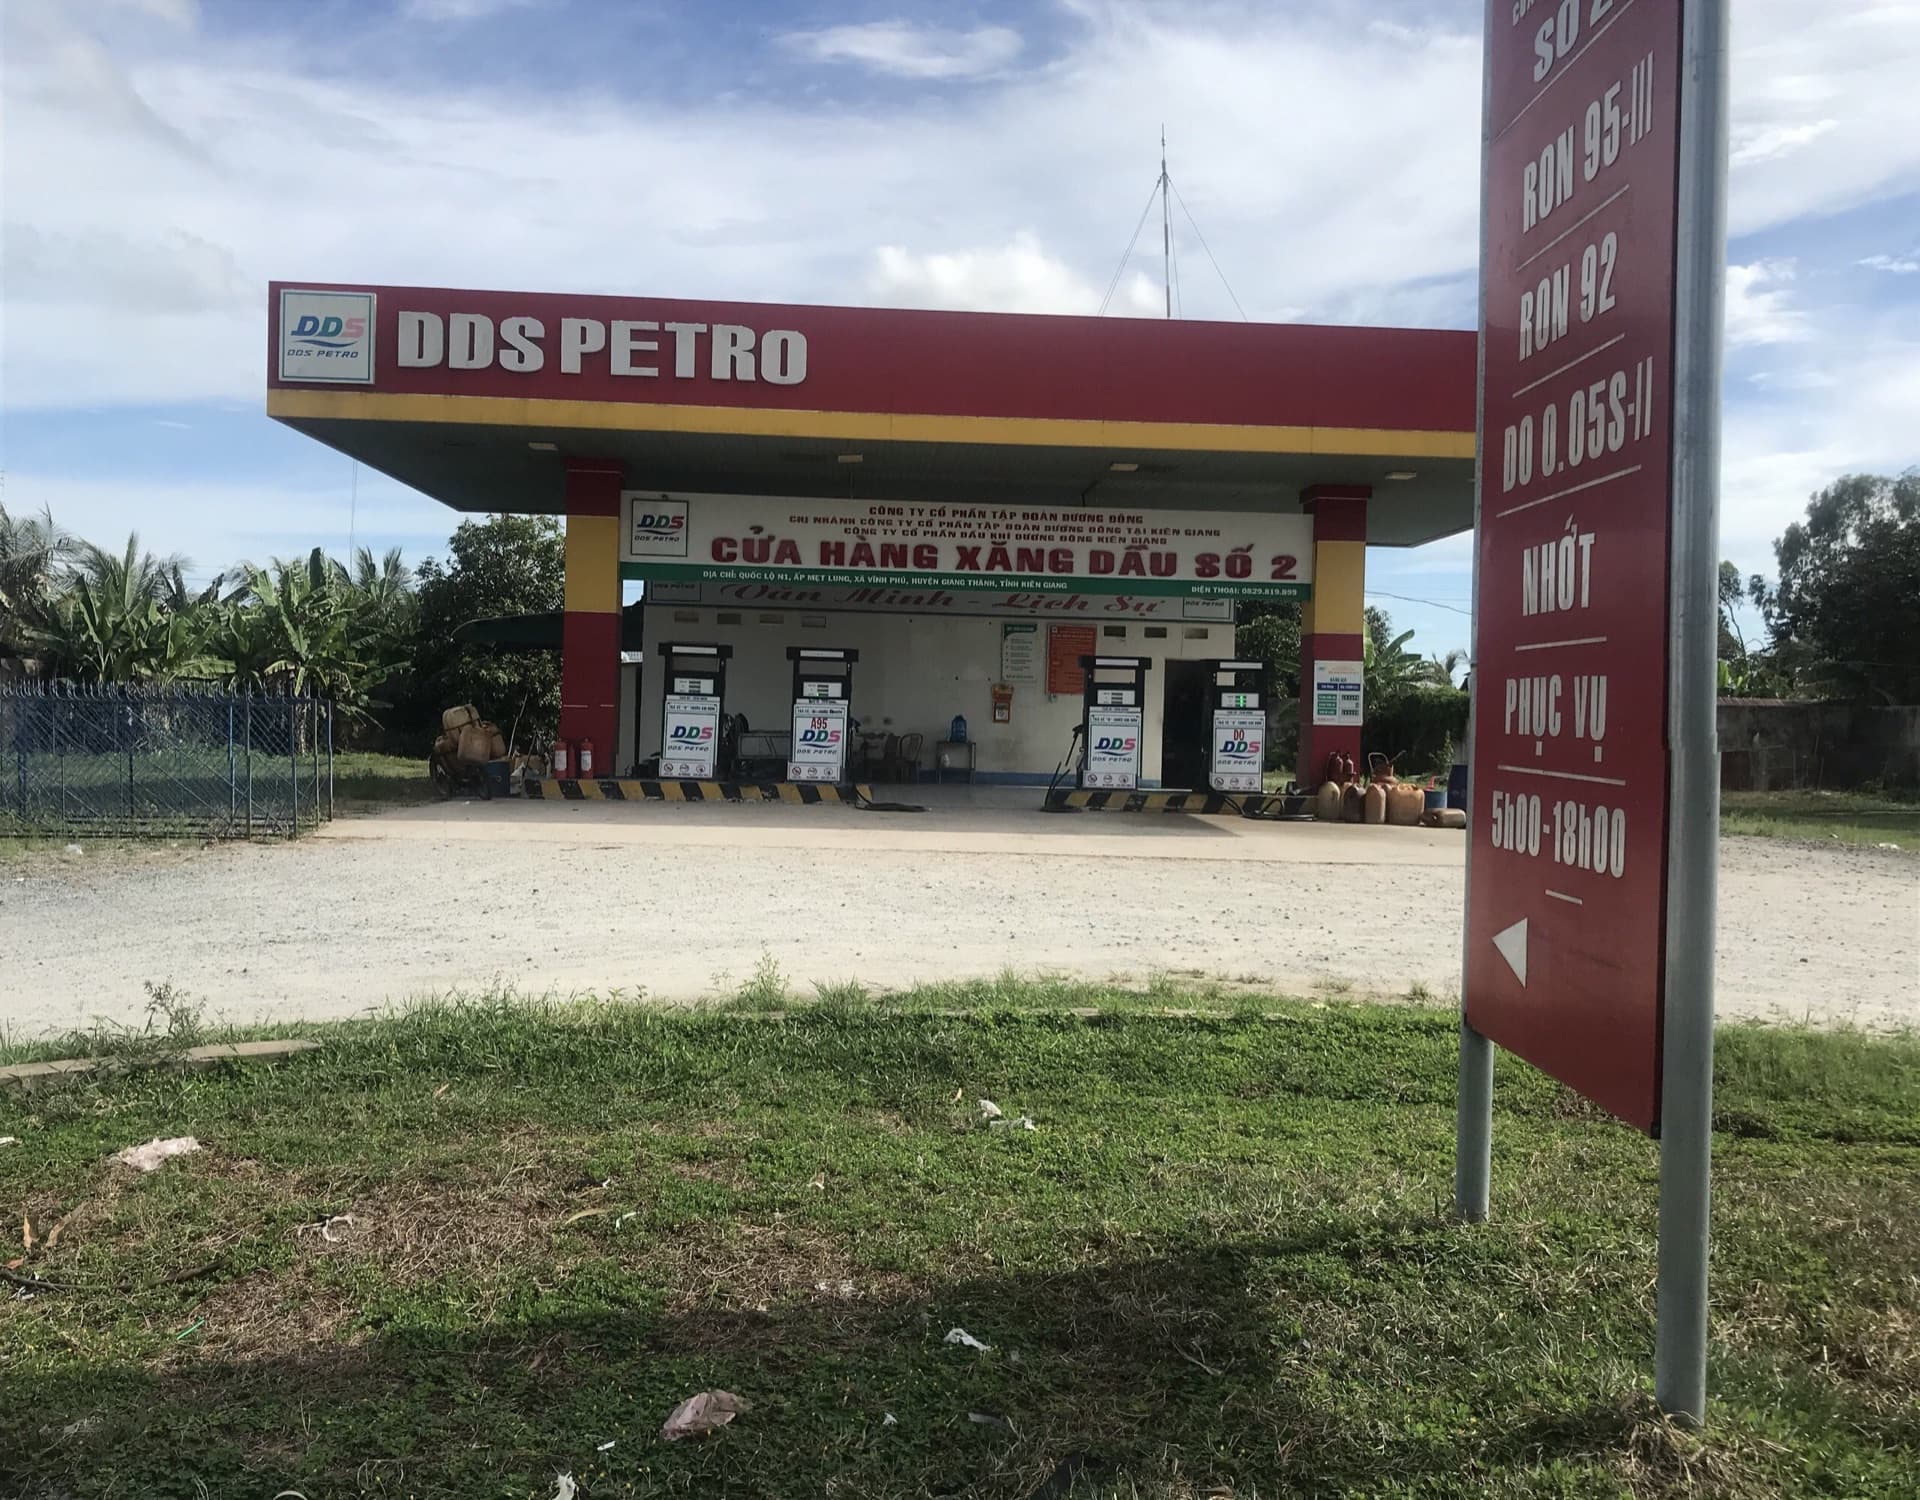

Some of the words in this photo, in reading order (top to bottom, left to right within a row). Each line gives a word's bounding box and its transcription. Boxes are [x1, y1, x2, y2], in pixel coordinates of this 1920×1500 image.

[1522, 124, 1574, 234] RON
[1583, 50, 1654, 182] 95-III
[1519, 263, 1570, 362] RON
[1580, 231, 1617, 323] 92
[290, 315, 366, 338] DDS
[287, 349, 313, 357] DDS
[316, 350, 359, 359] PETRO
[397, 311, 545, 372] DDS
[560, 317, 808, 385] PETRO
[1503, 414, 1534, 493] DO
[636, 514, 685, 529] DDS
[869, 505, 904, 516] CÔNG
[909, 507, 925, 517] TY
[991, 510, 1017, 522] TẬP
[789, 515, 809, 523] CHI
[860, 517, 893, 526] CÔNG
[898, 519, 912, 527] TY
[977, 521, 1001, 531] TẬP
[1127, 528, 1147, 536] TẠI
[1151, 527, 1181, 536] KIÊN
[1184, 529, 1221, 537] GIANG
[844, 526, 877, 535] CÔNG
[883, 528, 897, 536] TY
[1131, 537, 1167, 545] GIANG
[711, 525, 802, 565] CỬA
[819, 535, 938, 569] HÀNG
[955, 540, 1074, 574] XĂNG
[1195, 543, 1255, 579] SỐ
[1271, 555, 1297, 580] 2
[1522, 512, 1595, 617] NHỚT
[703, 570, 717, 579] ĐỊA
[738, 570, 762, 580] QUỐC
[764, 572, 775, 582] LỘ
[911, 576, 939, 586] HUYỆN
[941, 577, 966, 586] GIANG
[1021, 579, 1041, 588] KIÊN
[1043, 580, 1068, 589] GIANG
[991, 593, 1089, 614] Lịch
[1104, 594, 1166, 616] Sự
[810, 717, 828, 730] A95
[1504, 674, 1562, 756] PHỤC
[1573, 675, 1608, 762] VỤ
[670, 726, 713, 739] DDS
[799, 730, 841, 742] DDS
[1094, 737, 1136, 750] DDS
[1219, 741, 1261, 753] DDS
[1491, 790, 1626, 878] 5h00-18h00
